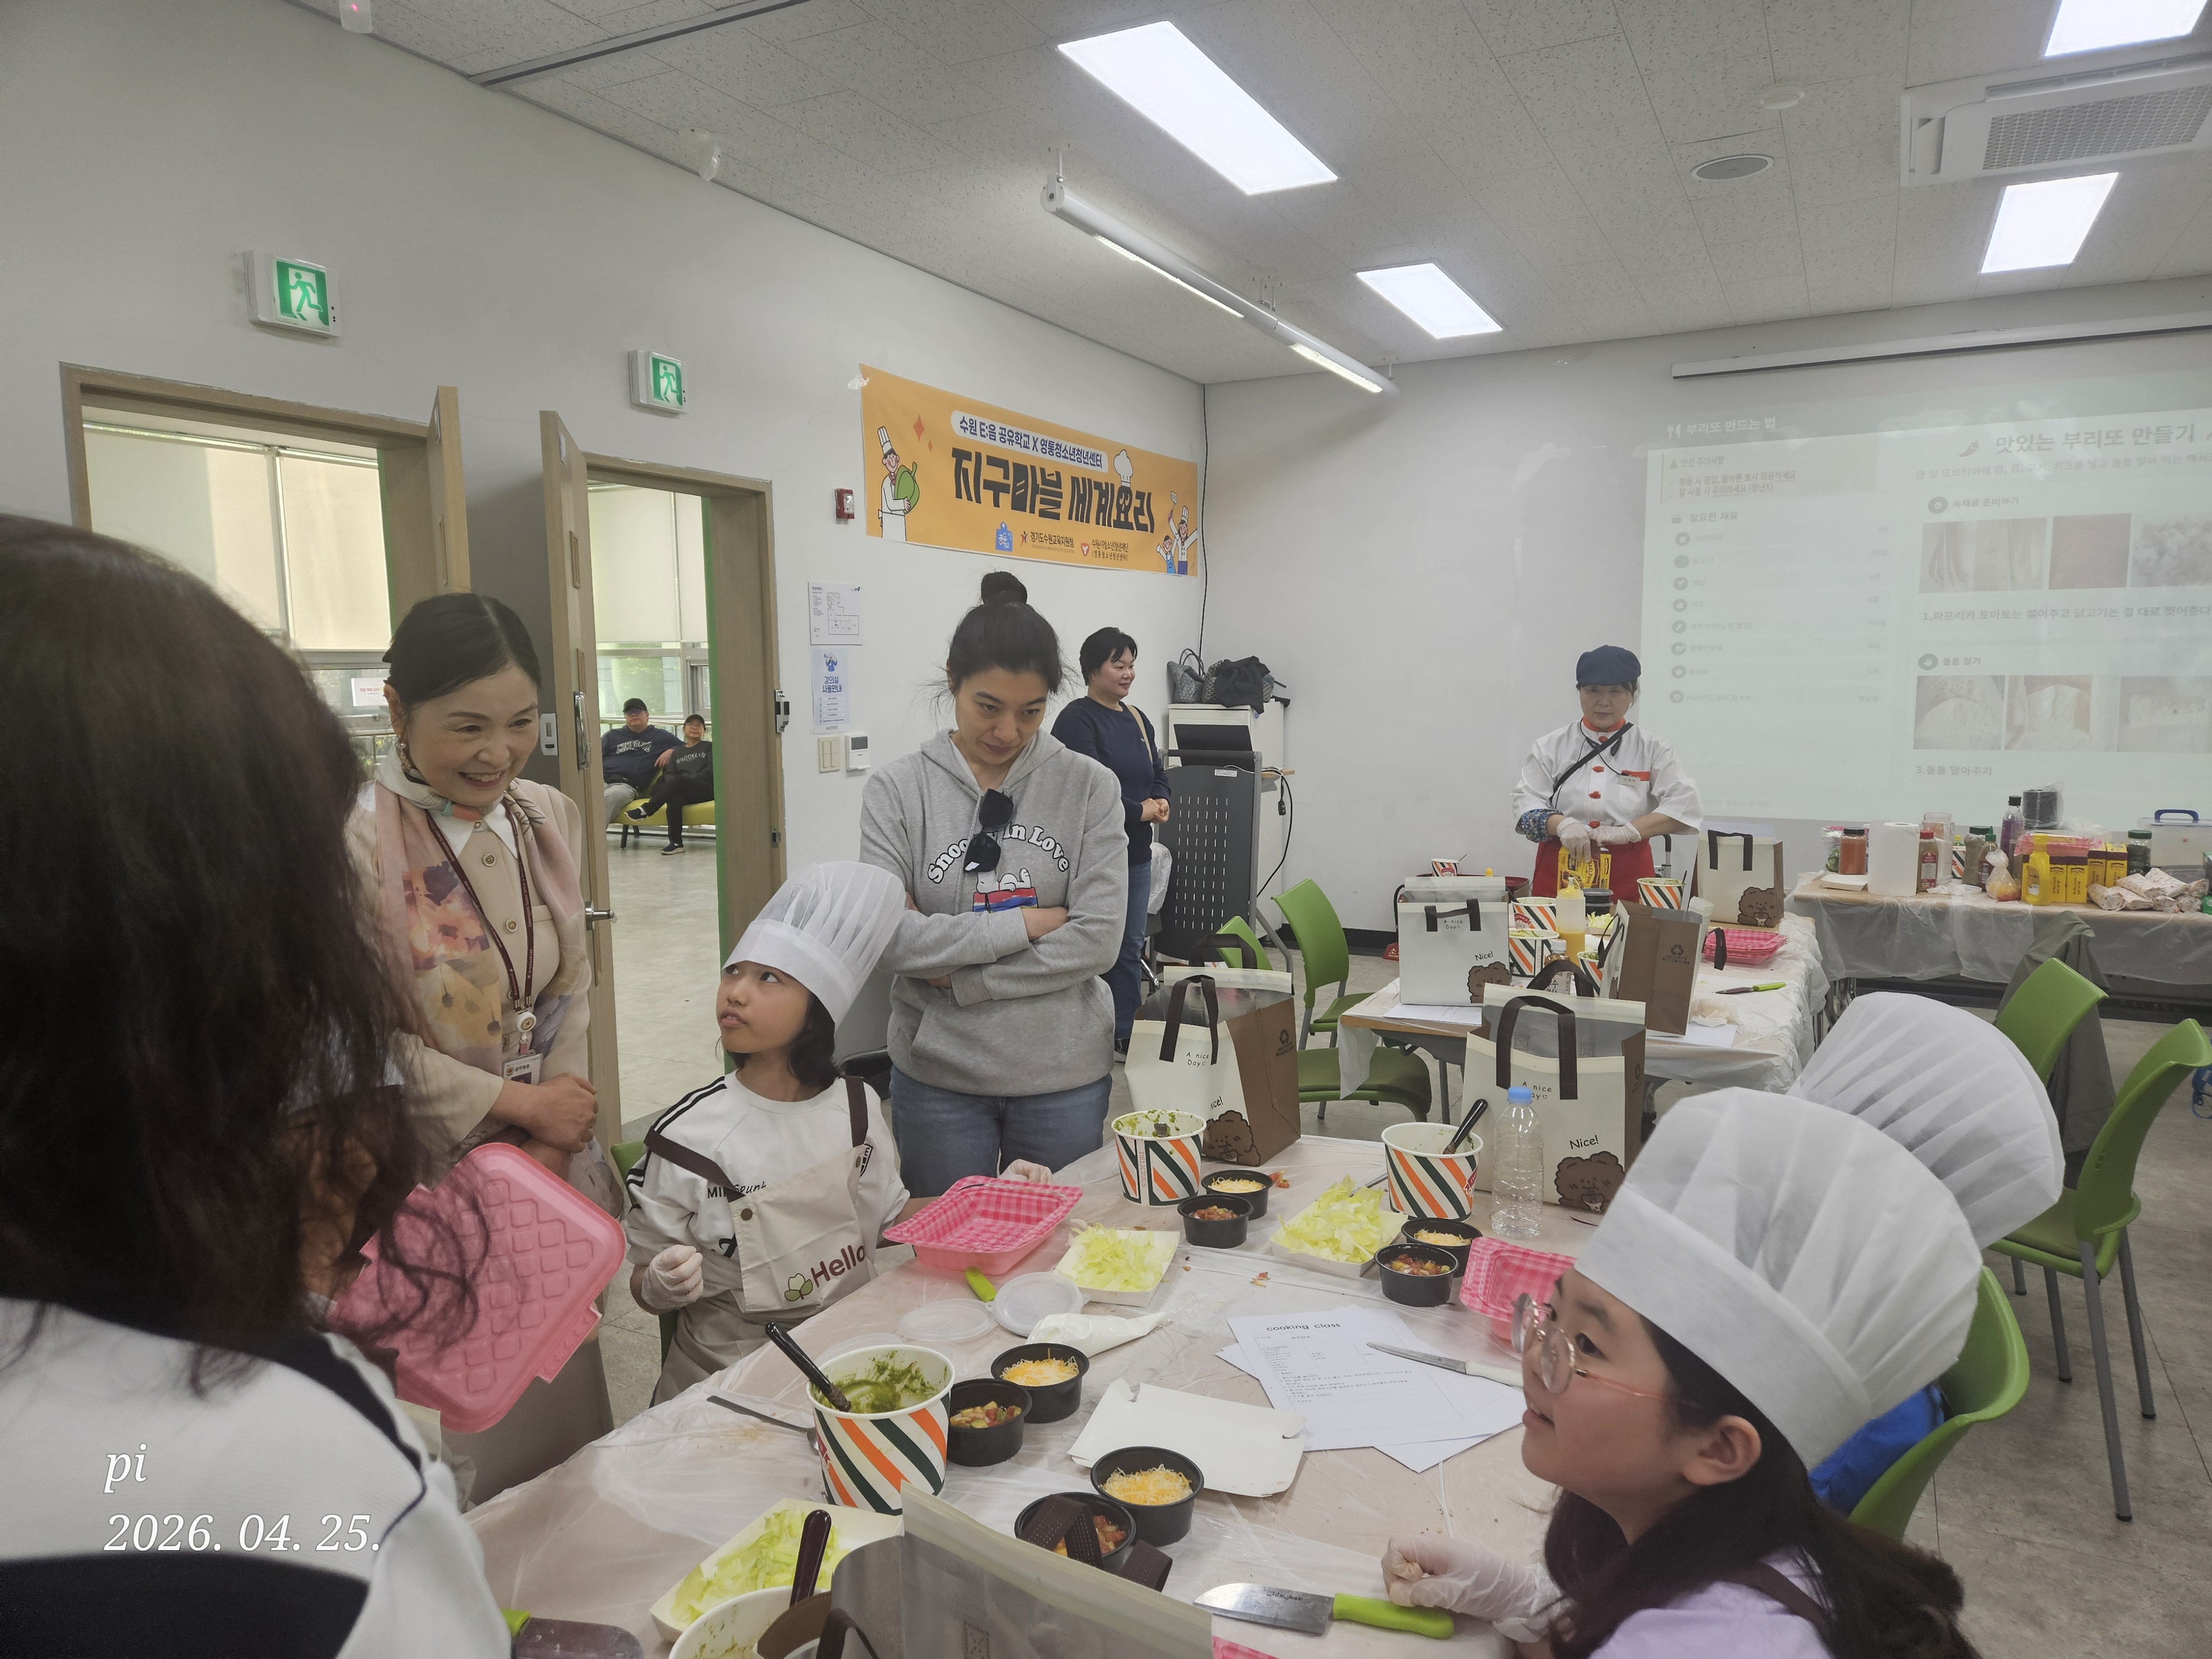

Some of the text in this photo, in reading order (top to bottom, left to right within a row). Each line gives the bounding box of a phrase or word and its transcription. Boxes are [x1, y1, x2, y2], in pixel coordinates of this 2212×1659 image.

[1687, 416, 1776, 435] 부리또 만드는 법
[960, 416, 1102, 468] 수원 E:음 공유학교 X 영통청소년청년센터
[1995, 424, 2194, 454] 맛있는 부리또 만들기
[1681, 456, 1724, 467] 안전 주의사항
[952, 447, 1155, 533] 지구마블 세계요리
[1712, 484, 1747, 495] 주의하세요
[1983, 497, 2019, 507] 준비하기
[1690, 511, 1739, 523] 필요한 재료
[1030, 531, 1074, 547] 경기도수원교육지원청
[1923, 611, 1975, 621] 1.파프리카
[1979, 610, 2022, 620] 토마토는
[824, 676, 839, 684] 강의실
[822, 685, 842, 693] 사용안내
[1950, 765, 1993, 776] 말아주기
[927, 839, 968, 883] Snoo
[1029, 826, 1070, 872] Love
[1475, 951, 1494, 961] Nice!
[1569, 1135, 1599, 1150] Nice!
[810, 1244, 865, 1287] Hello
